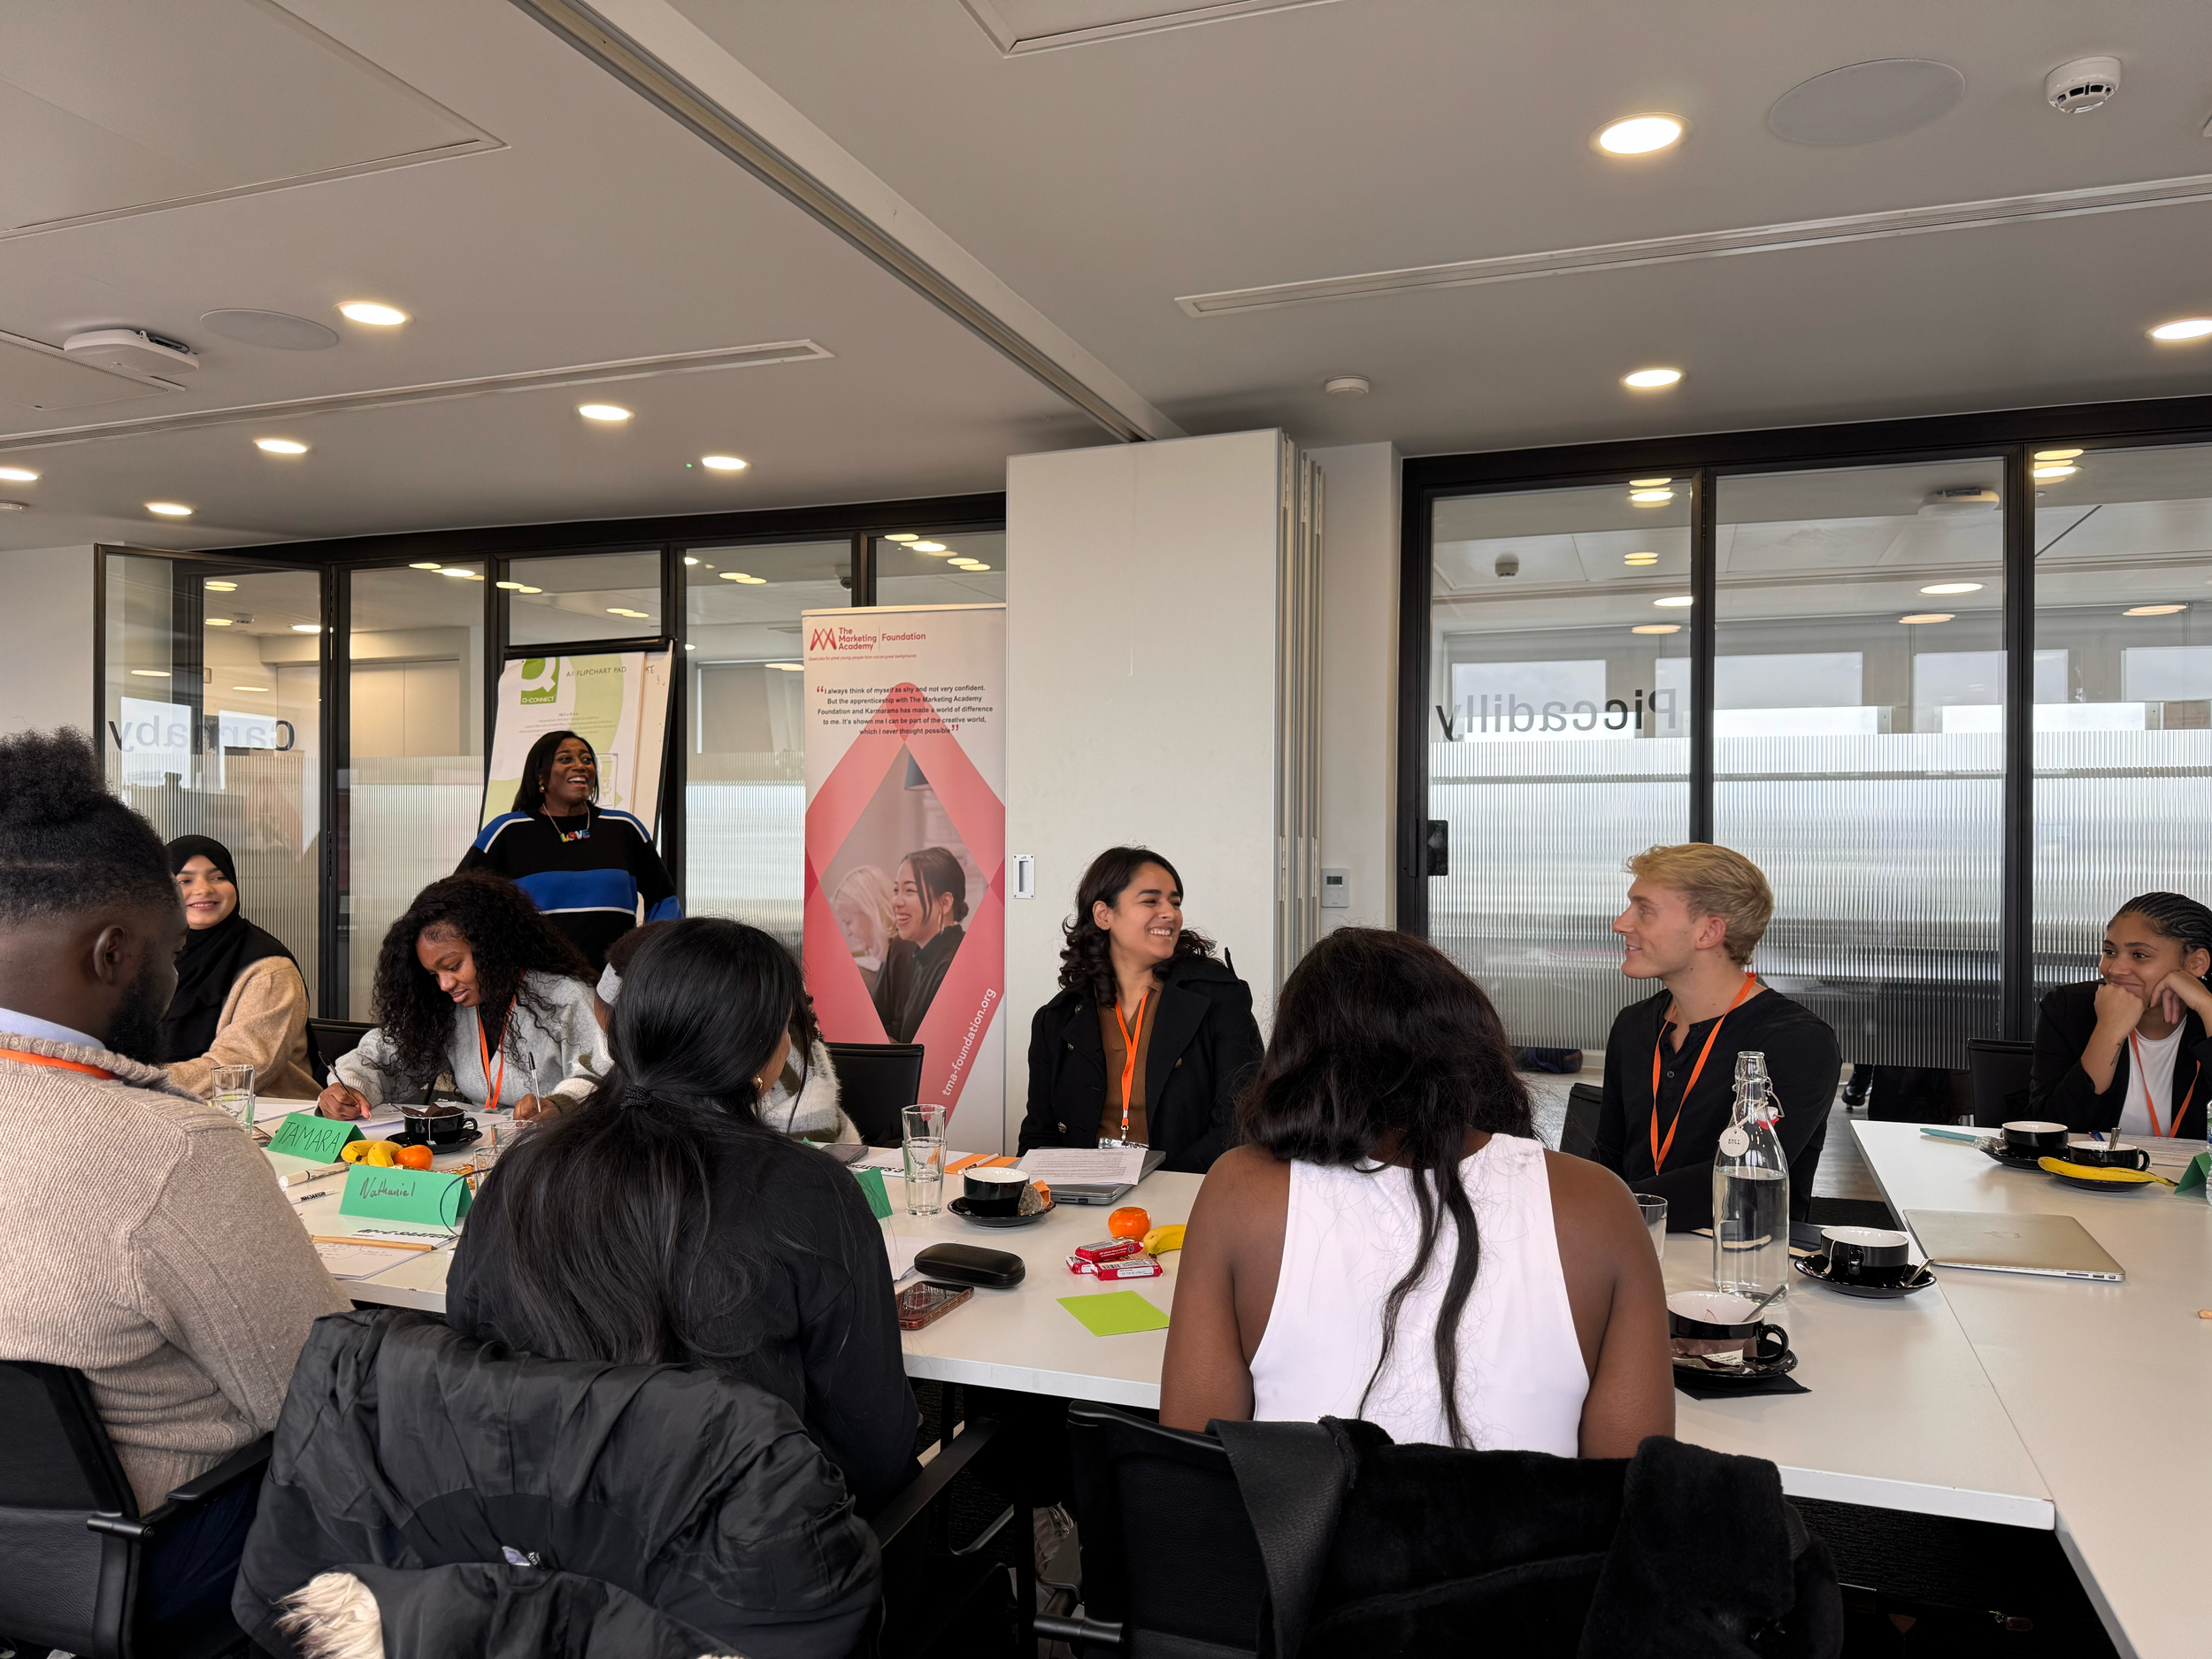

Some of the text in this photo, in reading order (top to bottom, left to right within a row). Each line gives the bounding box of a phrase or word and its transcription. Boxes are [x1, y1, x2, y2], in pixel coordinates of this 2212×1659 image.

[839, 634, 877, 643] Marketing
[881, 633, 926, 641] Foundation
[839, 642, 873, 651] Academy
[576, 667, 611, 676] FLIPCHART
[560, 829, 590, 842] LOVE
[941, 987, 996, 1096] tma-foundation.org
[278, 1121, 341, 1155] TAMARA
[359, 1177, 416, 1199] Nathaniel
